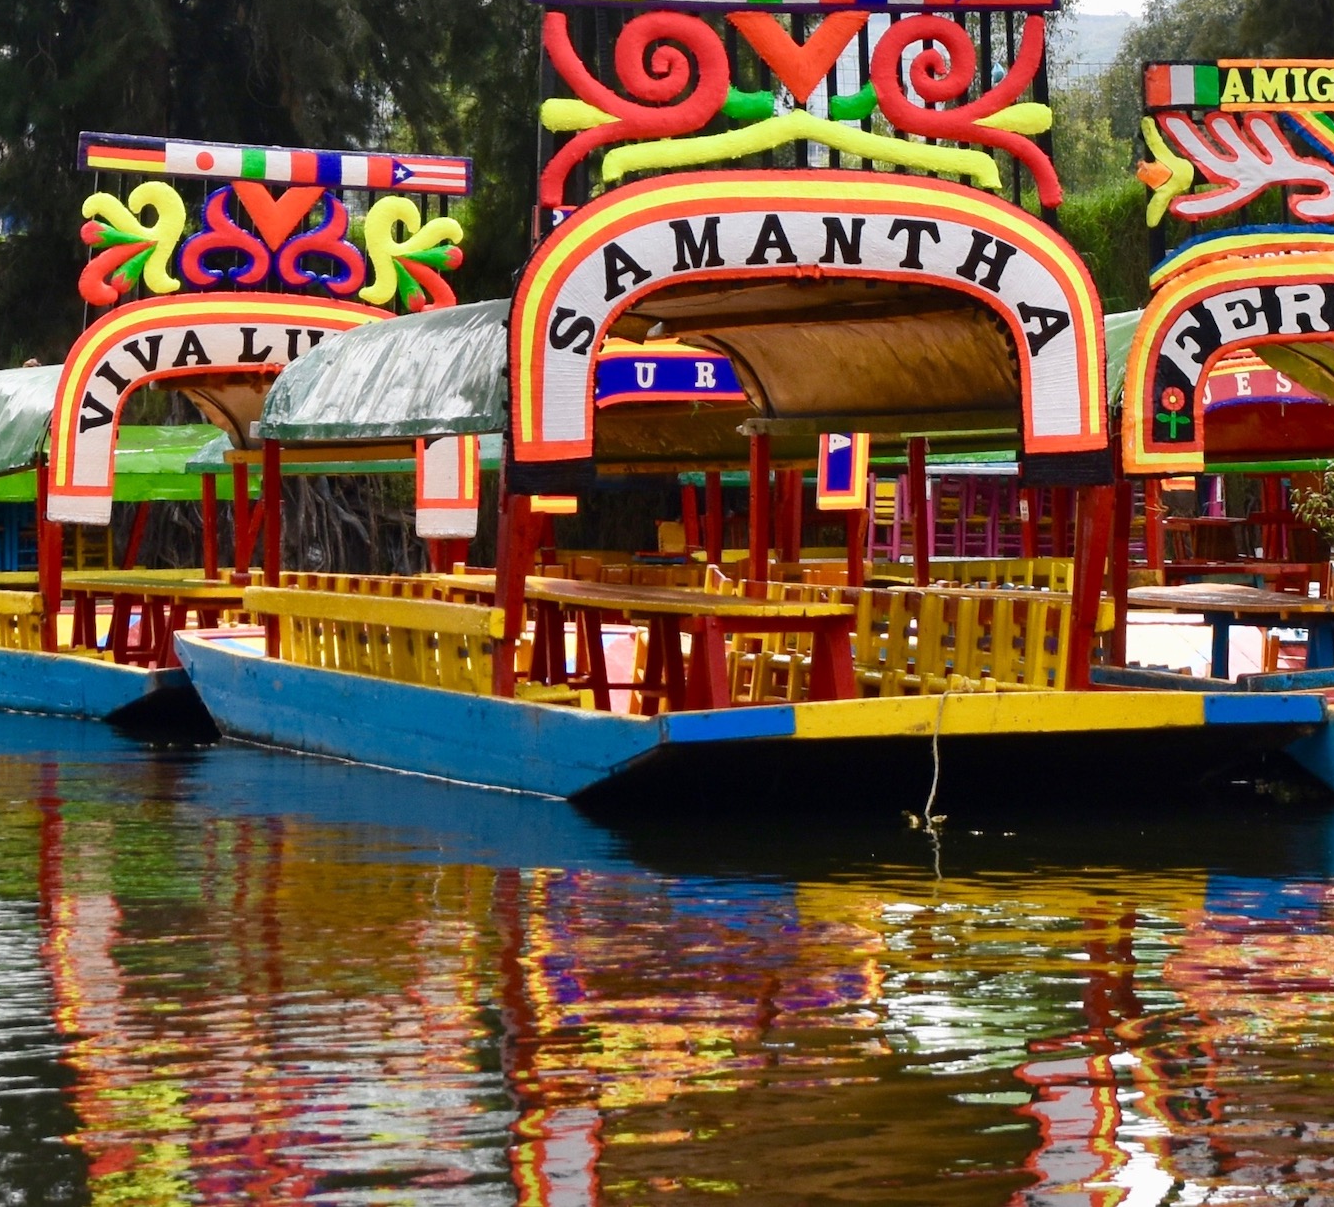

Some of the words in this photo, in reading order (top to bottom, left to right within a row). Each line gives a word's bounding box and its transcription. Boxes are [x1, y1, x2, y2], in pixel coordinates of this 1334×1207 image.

[549, 213, 1070, 358] SAMANTHA
[79, 329, 212, 433] VIVA
[237, 327, 337, 363] LU
